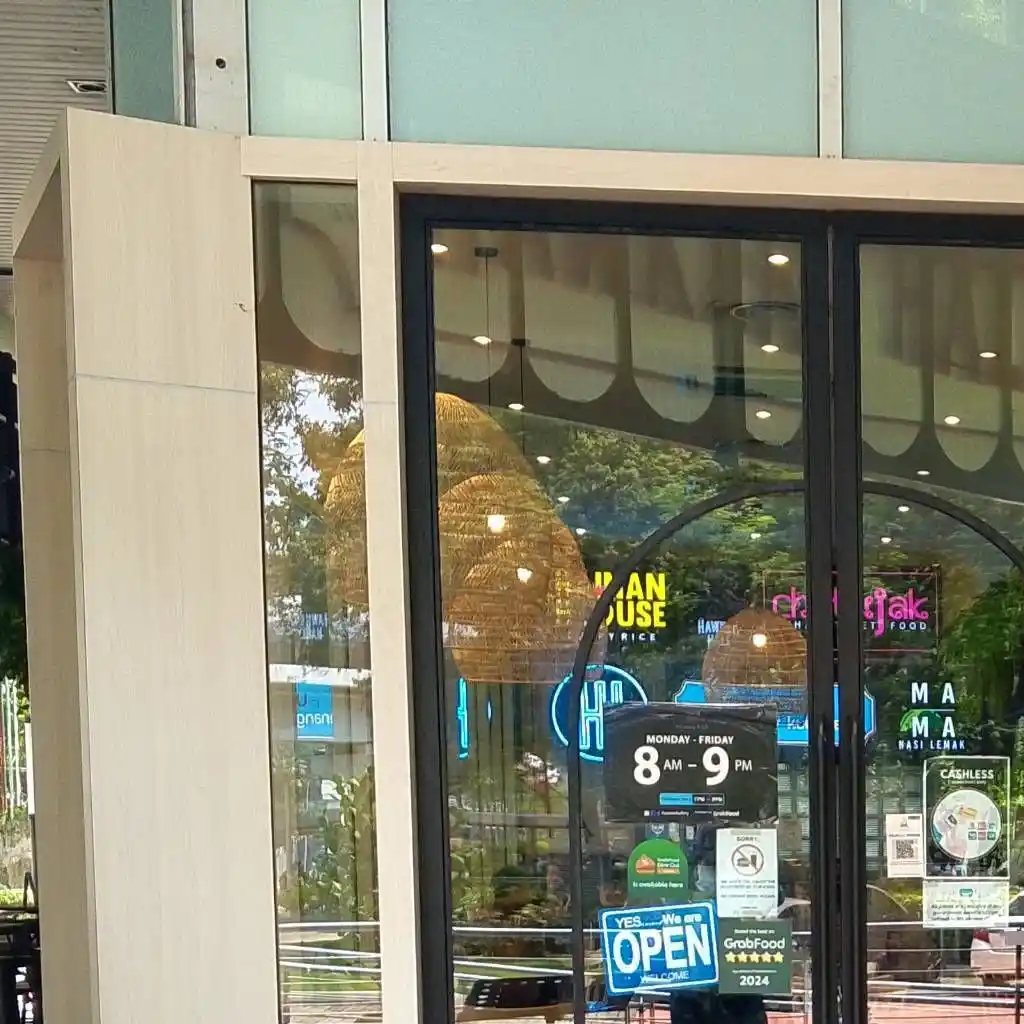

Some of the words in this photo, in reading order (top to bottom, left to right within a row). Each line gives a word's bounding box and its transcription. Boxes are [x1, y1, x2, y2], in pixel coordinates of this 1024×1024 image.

[890, 621, 927, 631] FOOD
[621, 632, 656, 642] RICE
[646, 735, 690, 744] MONDAY
[699, 735, 734, 745] FRIDAY
[930, 740, 966, 750] LEMAK
[633, 745, 661, 786] 8
[663, 759, 682, 771] AM
[702, 746, 730, 786] 9
[735, 760, 752, 771] PM
[940, 769, 995, 780] CASHLESS
[683, 913, 702, 923] are
[724, 937, 786, 949] GrabFood
[613, 924, 711, 974] OPEN
[740, 975, 770, 987] 2024
